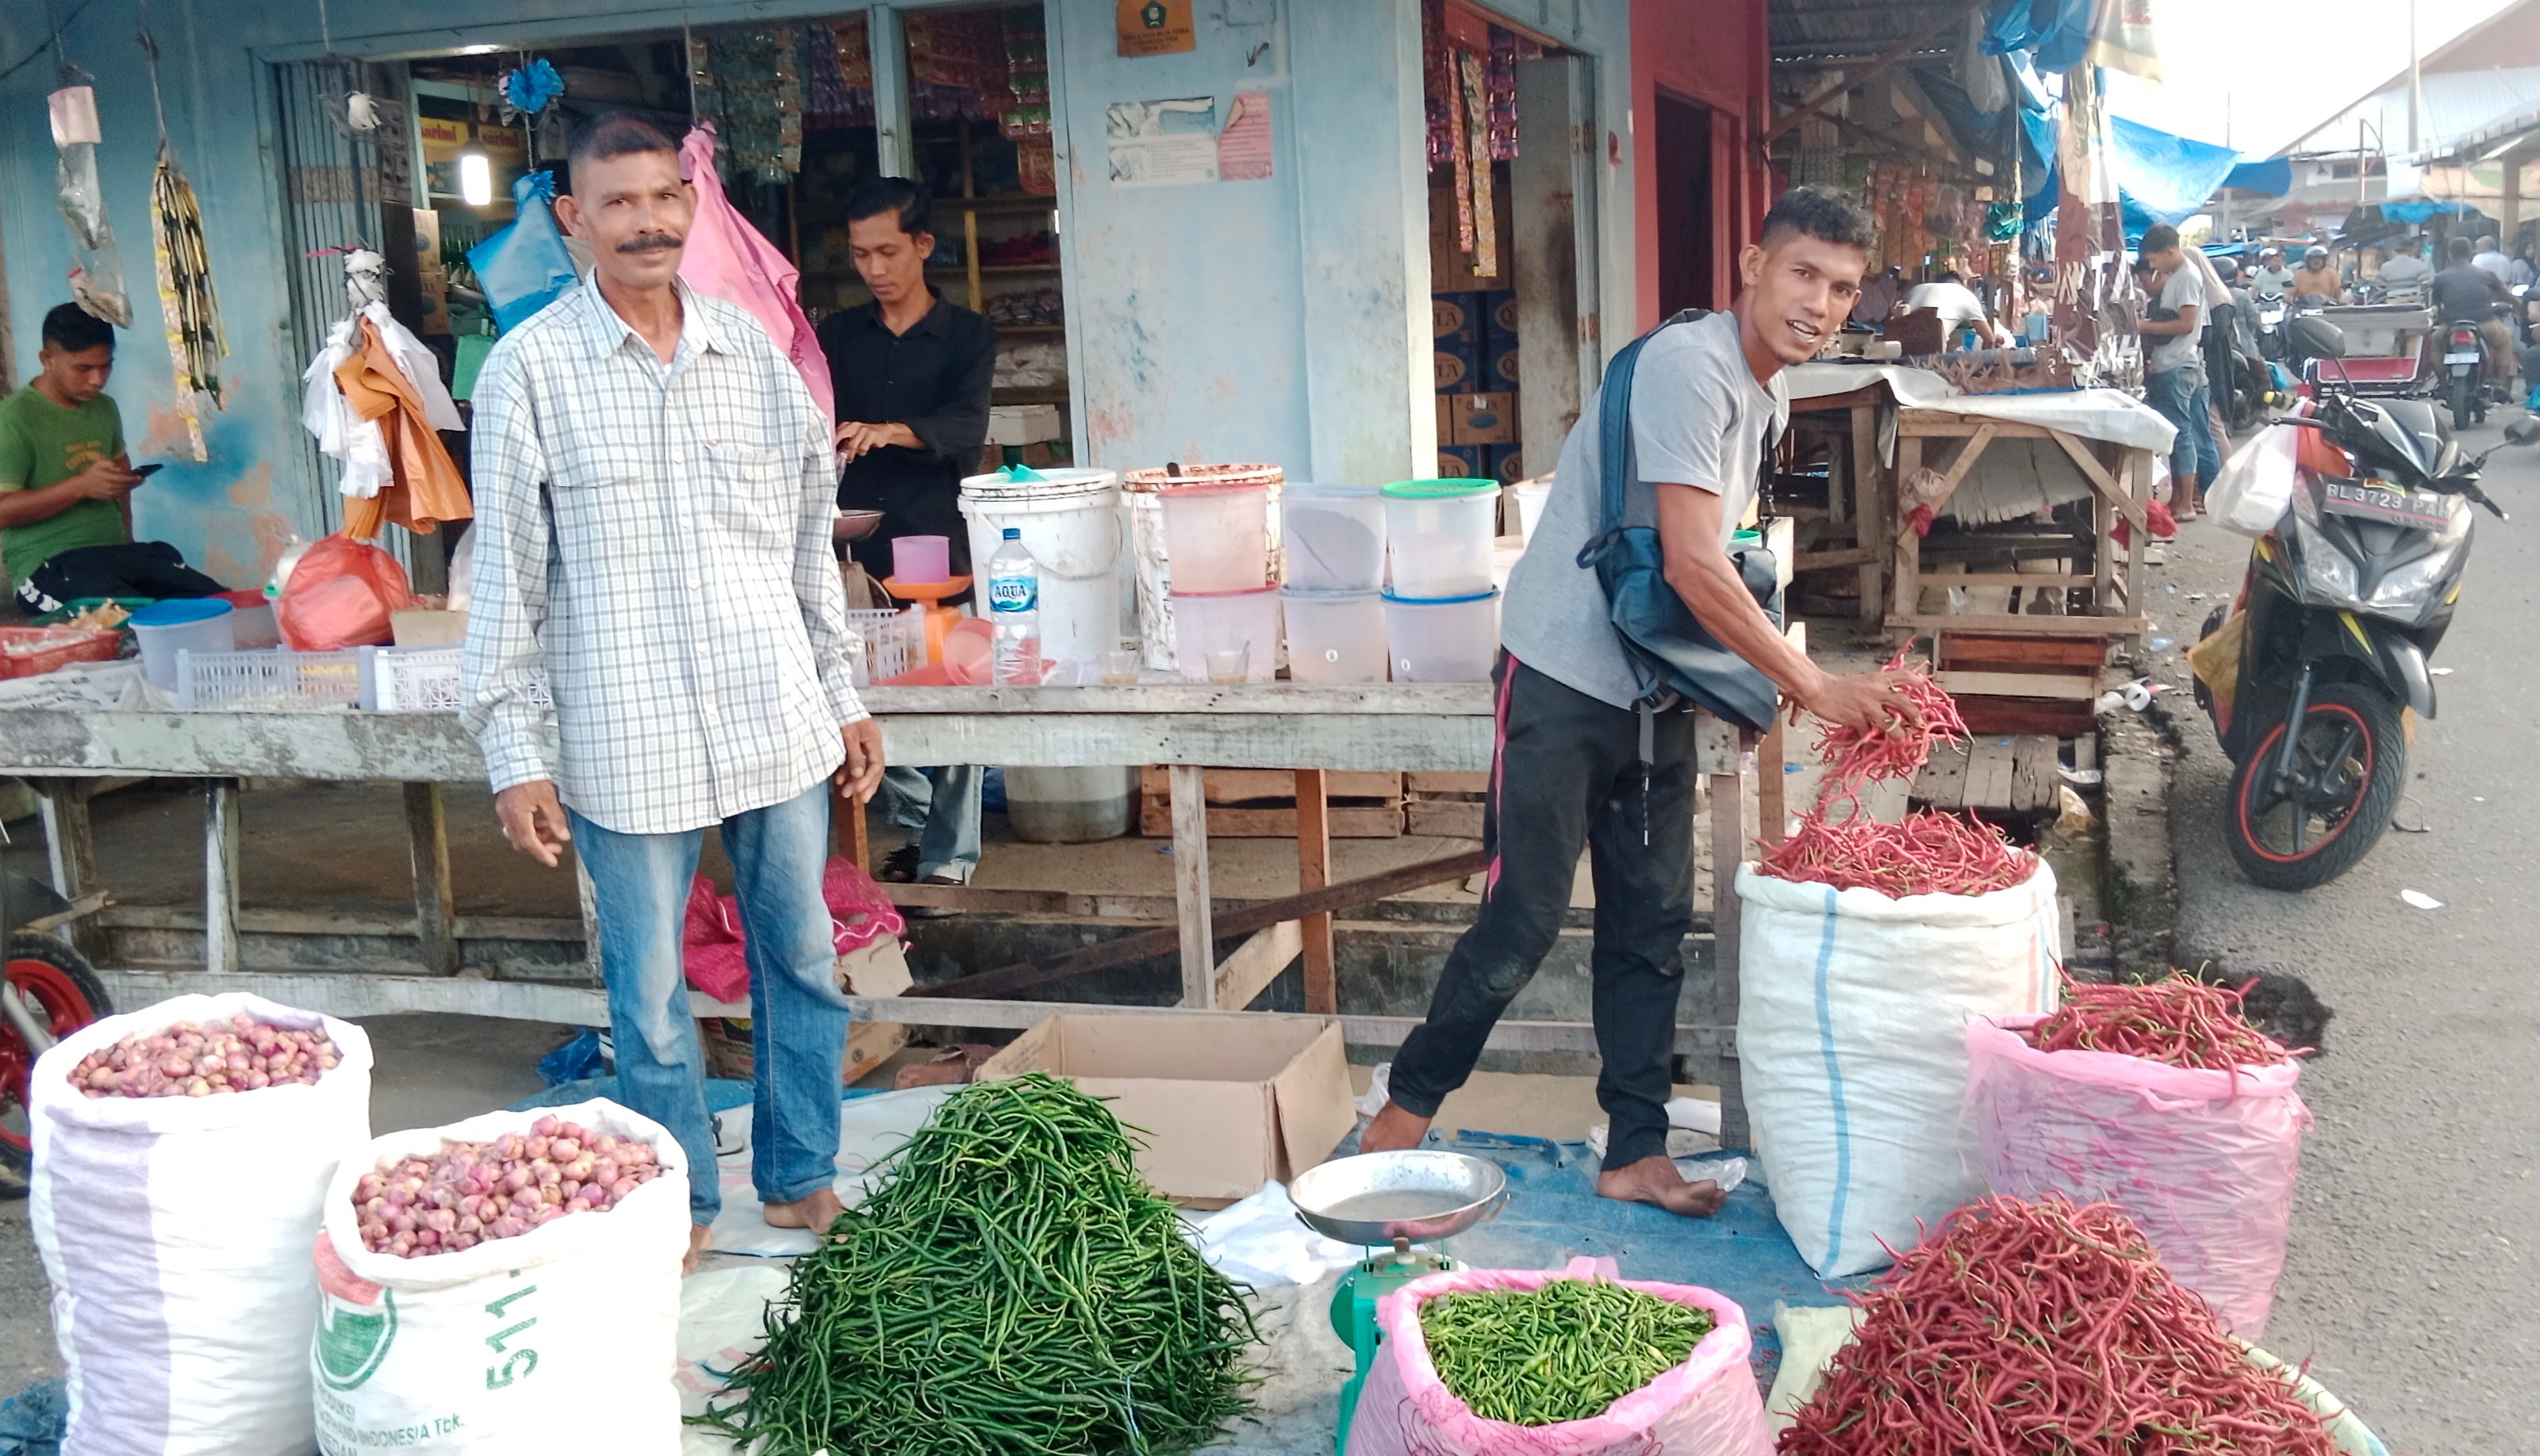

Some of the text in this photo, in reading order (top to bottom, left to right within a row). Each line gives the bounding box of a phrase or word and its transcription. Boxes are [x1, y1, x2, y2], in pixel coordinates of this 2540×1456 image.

[2326, 483, 2350, 500] BL
[995, 584, 1026, 600] AQUA
[356, 1423, 431, 1447] INDONESIA
